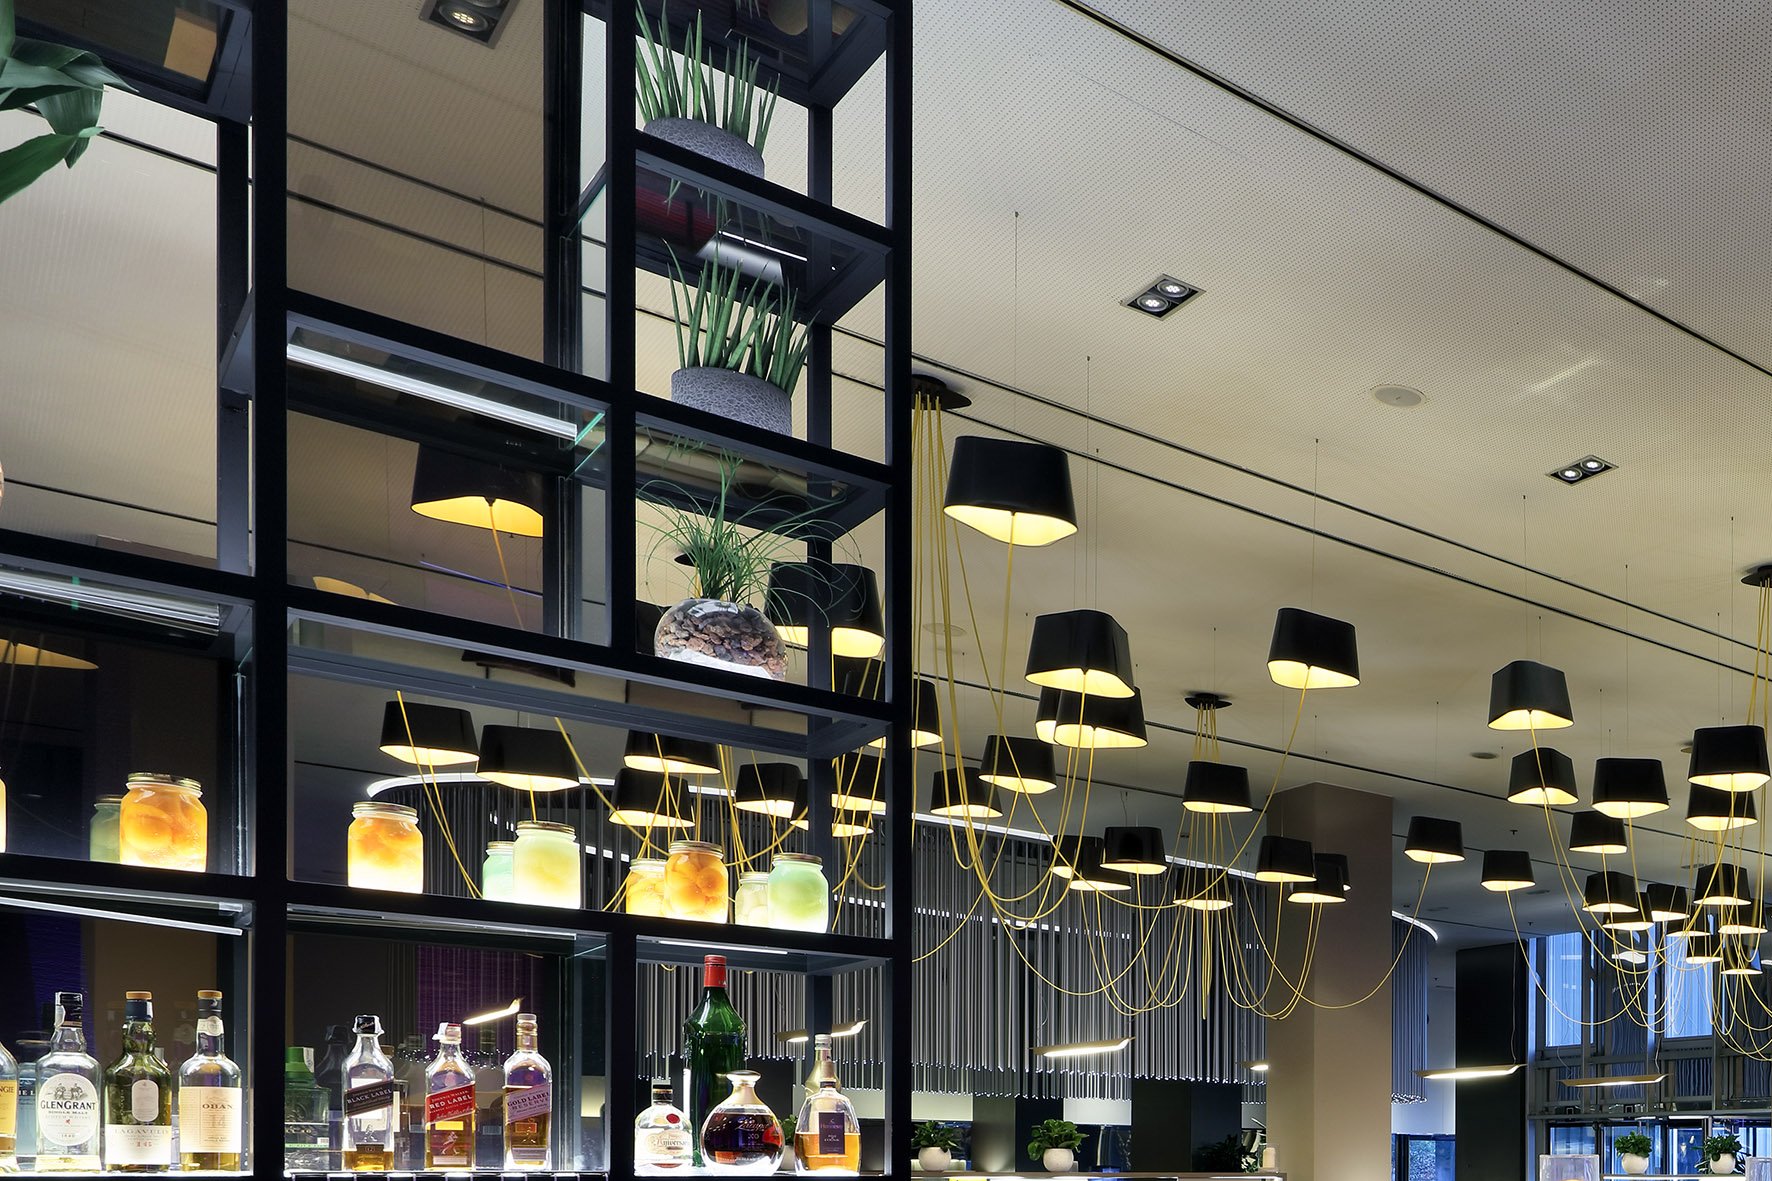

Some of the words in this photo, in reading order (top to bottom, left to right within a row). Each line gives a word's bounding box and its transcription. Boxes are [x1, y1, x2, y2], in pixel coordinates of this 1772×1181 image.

[346, 1094, 370, 1104] BLACK
[370, 1088, 392, 1098] LABEL
[429, 1101, 446, 1110] RED
[446, 1094, 473, 1105] LABEL
[507, 1098, 527, 1106] GOLD
